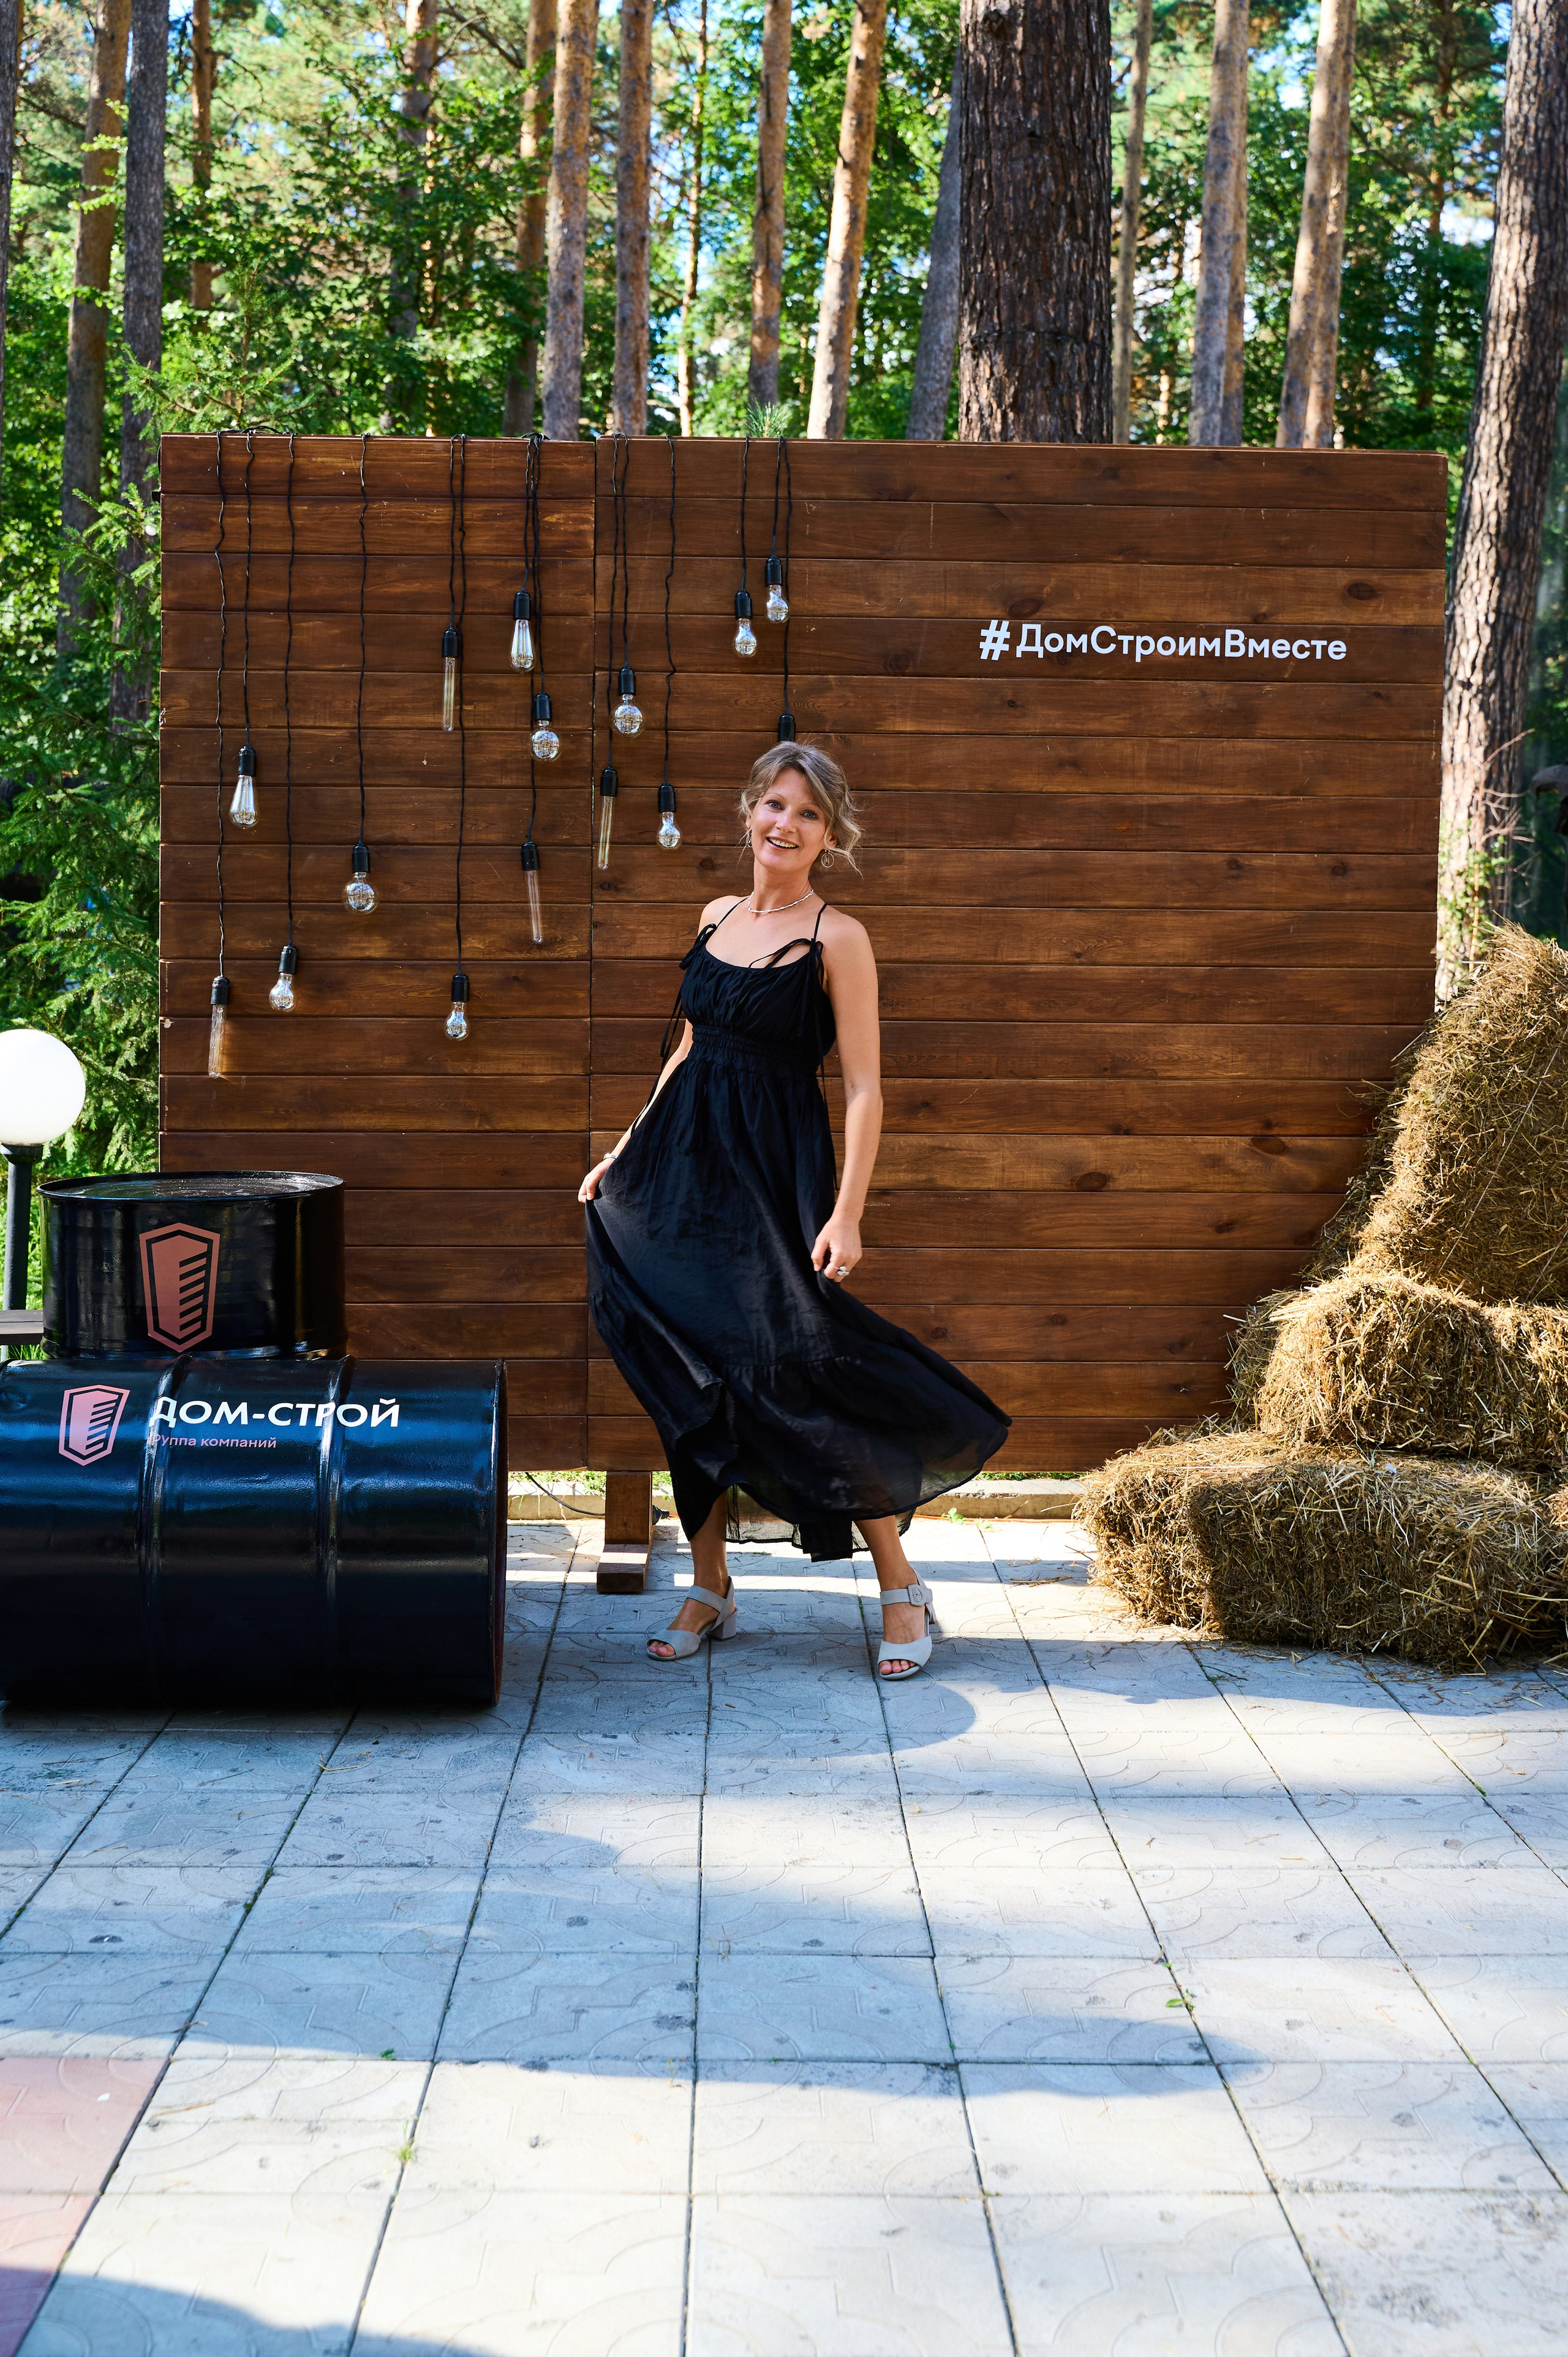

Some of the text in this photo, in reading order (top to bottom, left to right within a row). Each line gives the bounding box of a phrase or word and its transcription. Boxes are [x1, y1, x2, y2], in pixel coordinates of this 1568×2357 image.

[979, 619, 1347, 663] #ДомСтроимВместе
[149, 1396, 400, 1428] ДОМ-СТРОЙ
[147, 1433, 277, 1448] руппа компаний
